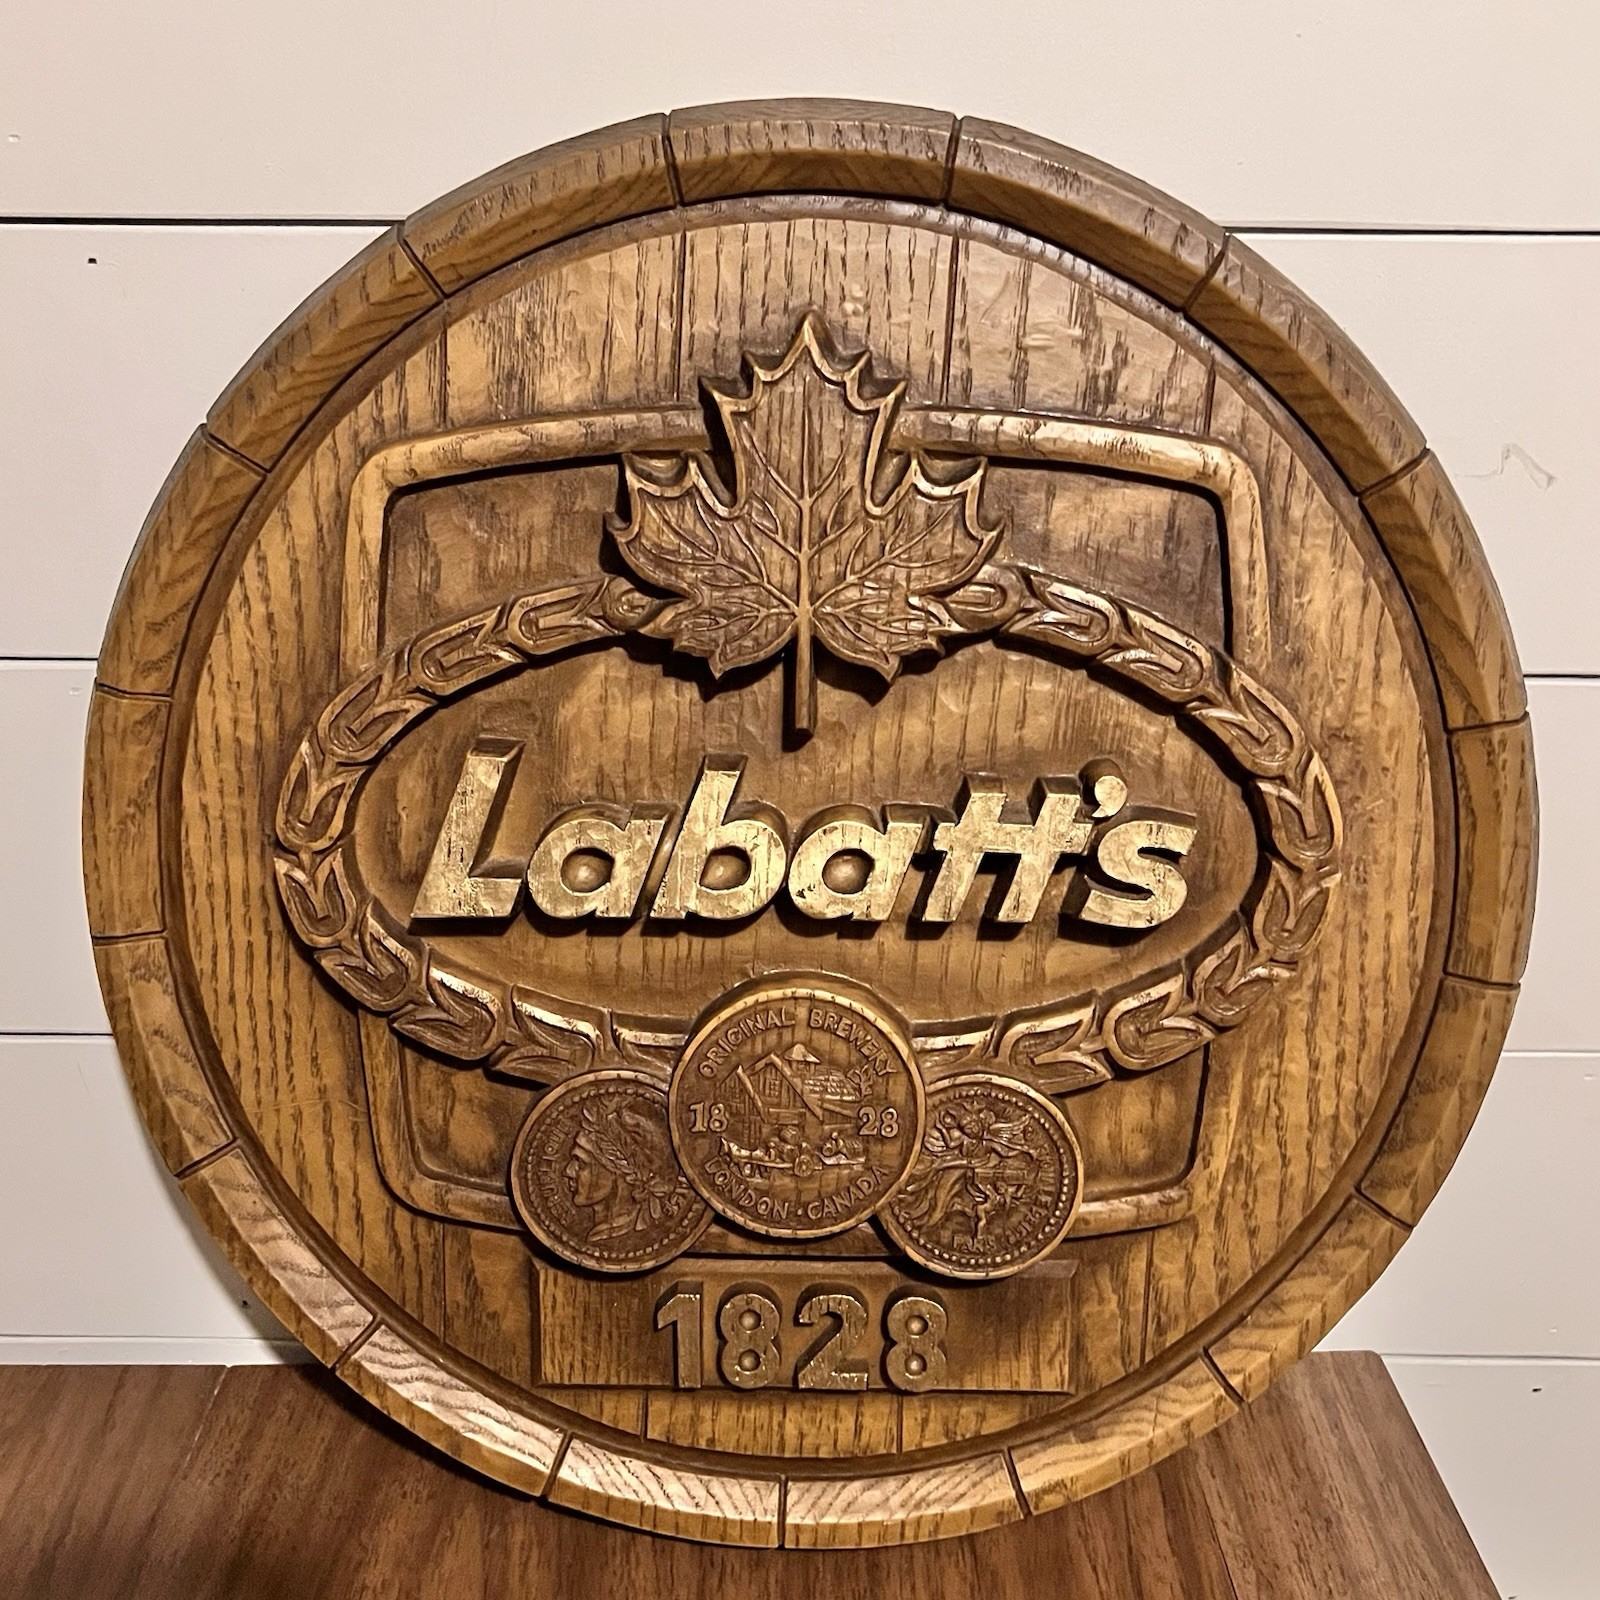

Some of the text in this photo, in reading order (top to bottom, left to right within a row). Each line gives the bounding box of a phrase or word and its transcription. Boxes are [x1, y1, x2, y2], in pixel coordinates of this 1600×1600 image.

[411, 746, 1198, 928] Labatt's
[699, 1006, 898, 1078] ORIGINAL BREWERY
[689, 1101, 900, 1138] 18 28
[704, 1156, 789, 1220] LONDON
[807, 1164, 896, 1220] CANADA
[656, 1288, 948, 1392] 1828
